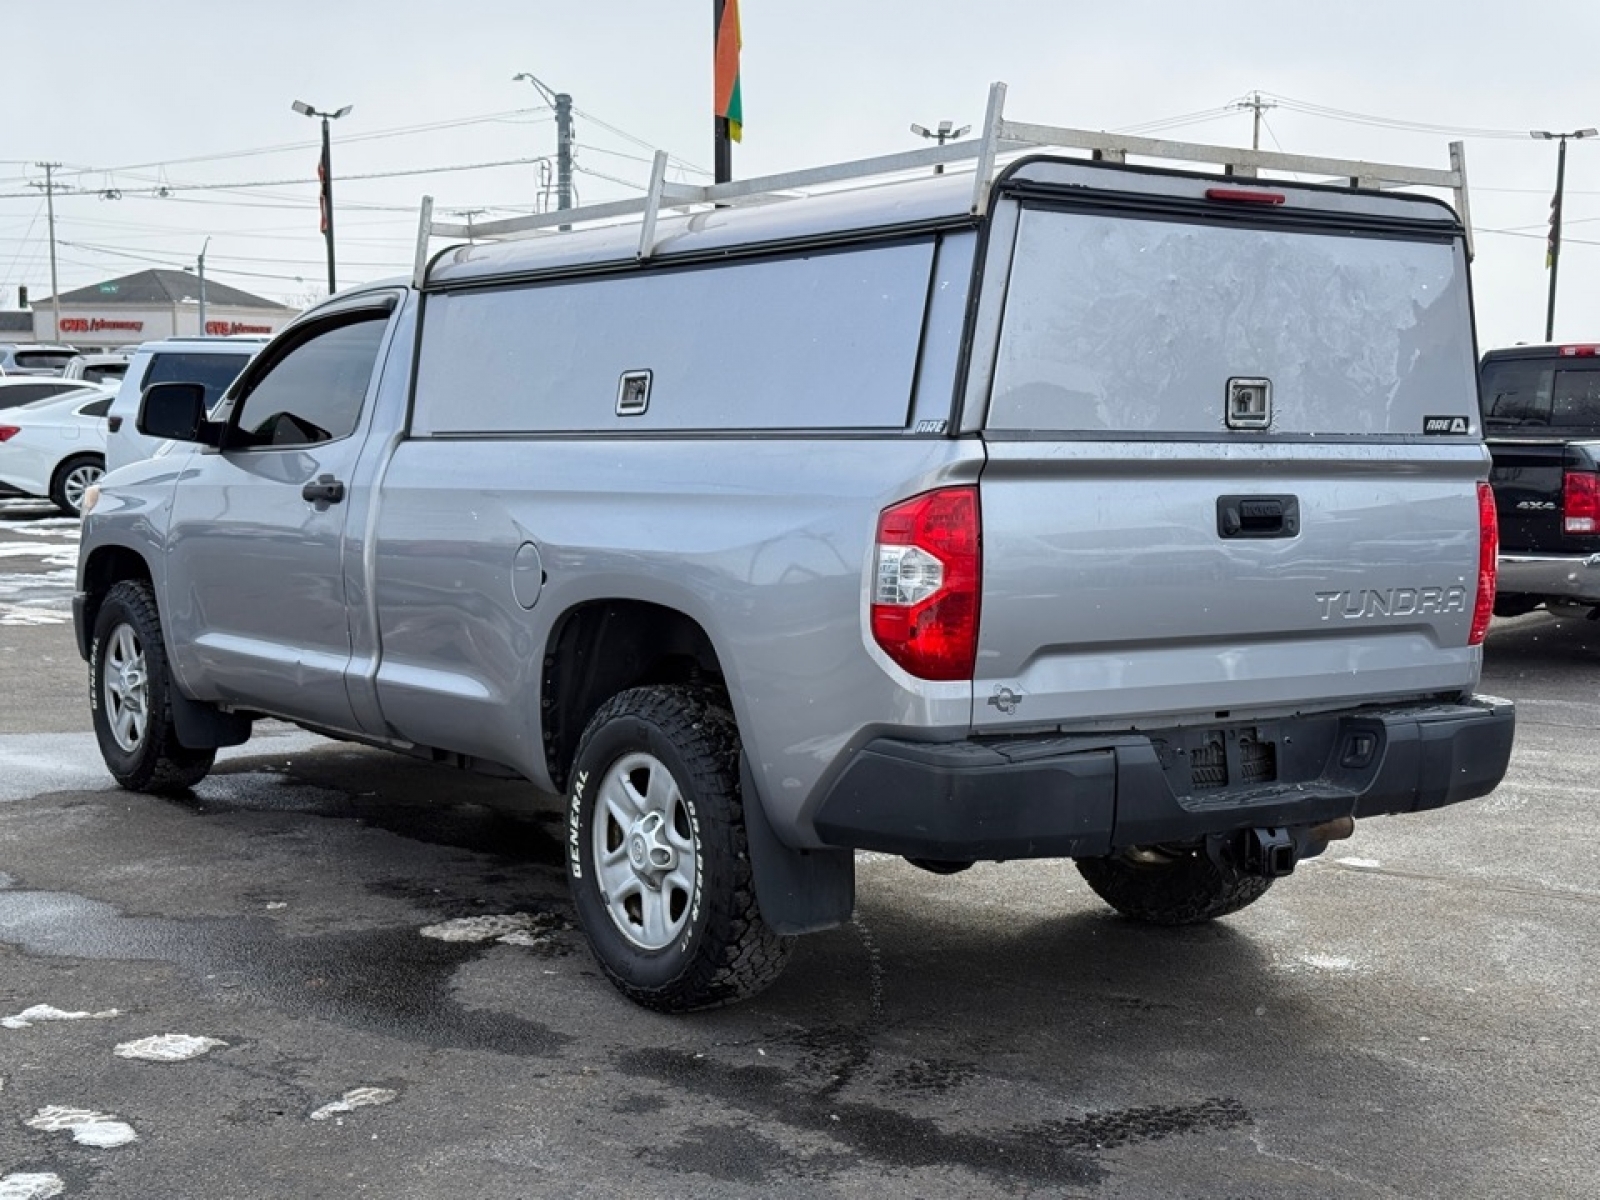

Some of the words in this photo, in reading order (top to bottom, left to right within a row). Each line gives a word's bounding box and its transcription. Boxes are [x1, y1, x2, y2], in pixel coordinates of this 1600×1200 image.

[1426, 419, 1451, 431] ARE
[1315, 584, 1467, 621] TUNDRA
[569, 770, 588, 879] GENERAL
